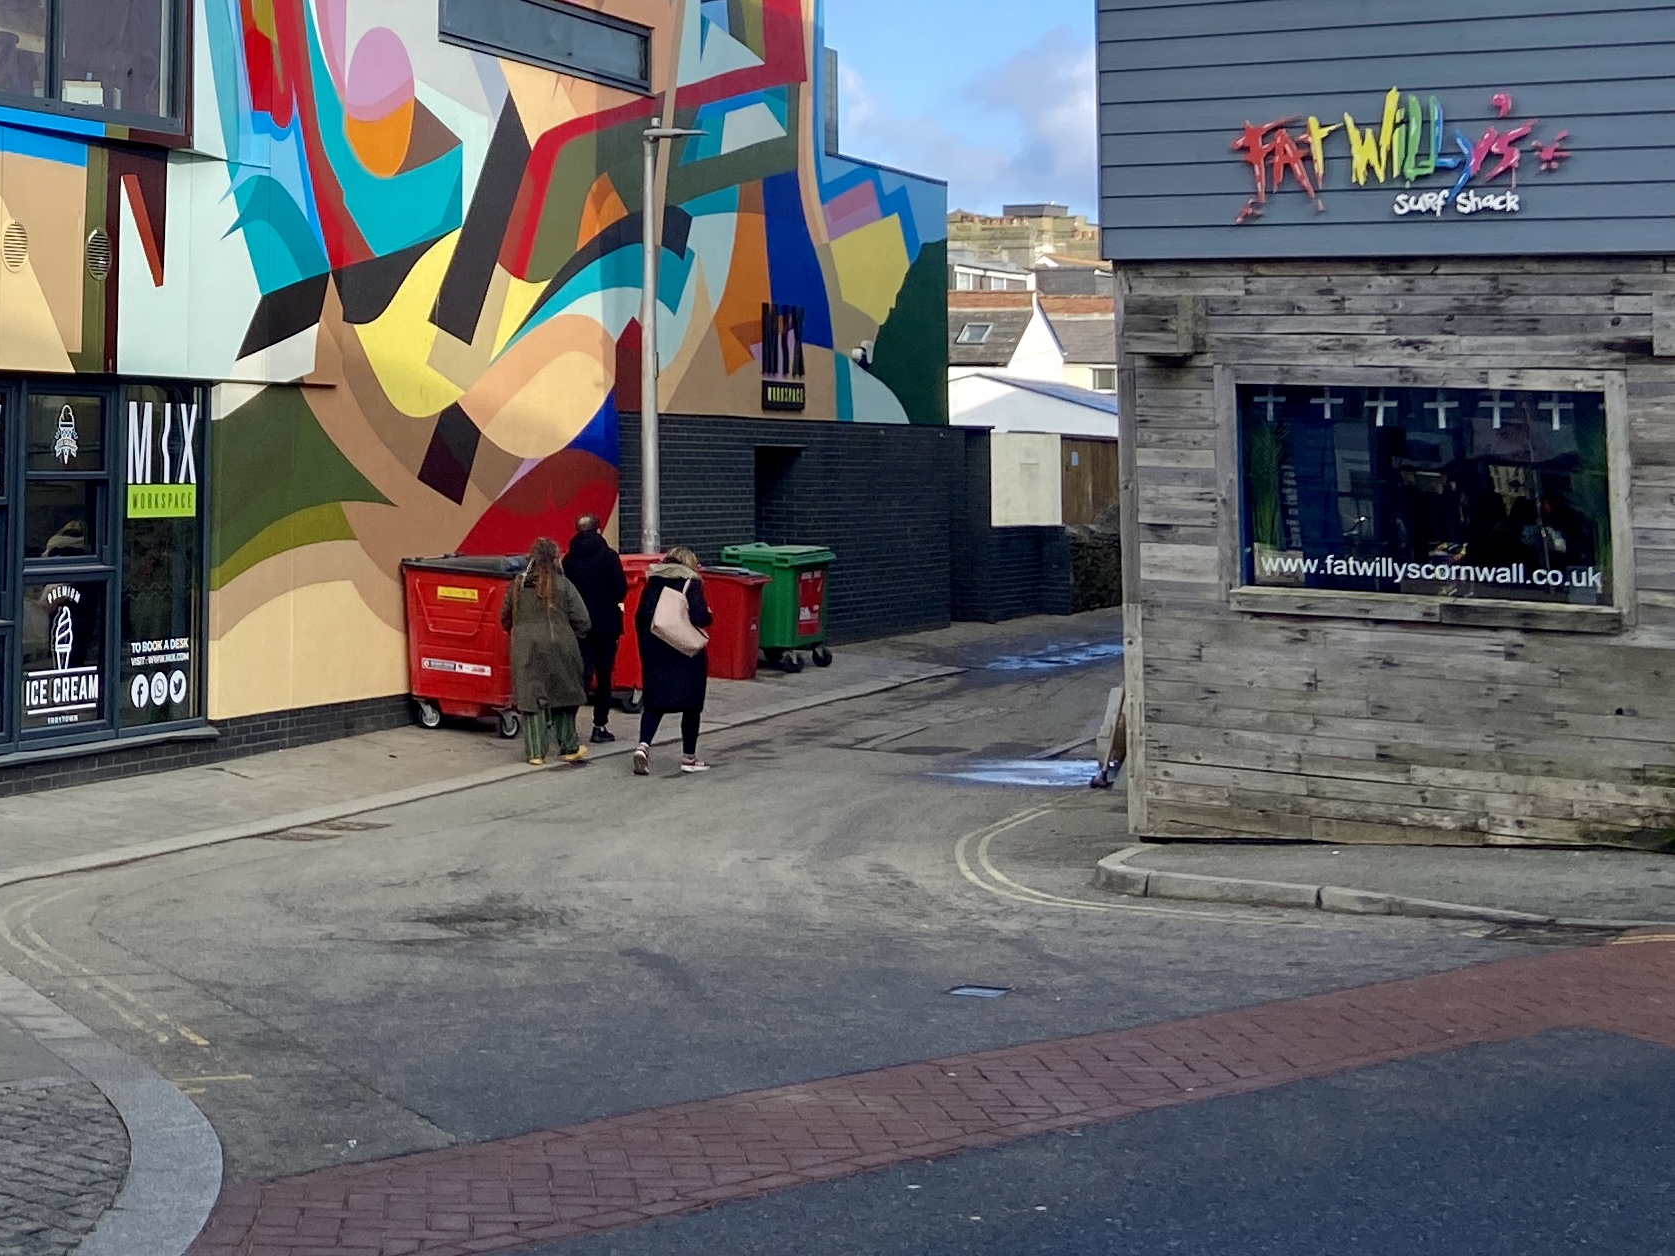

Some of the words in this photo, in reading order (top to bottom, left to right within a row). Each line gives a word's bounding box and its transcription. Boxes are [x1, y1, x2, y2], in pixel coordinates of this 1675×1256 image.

[1231, 115, 1343, 204] FAT
[127, 401, 197, 484] MIX
[132, 492, 192, 510] WORKSPACE
[1260, 554, 1602, 588] www.fatwillyscornwall.co.uk
[47, 585, 81, 604] PREMIUM
[131, 641, 142, 654] TO
[142, 639, 163, 653] BOOK
[164, 639, 169, 650] A
[170, 637, 189, 650] DESK
[26, 679, 48, 706] ICE
[52, 674, 99, 704] CREAM
